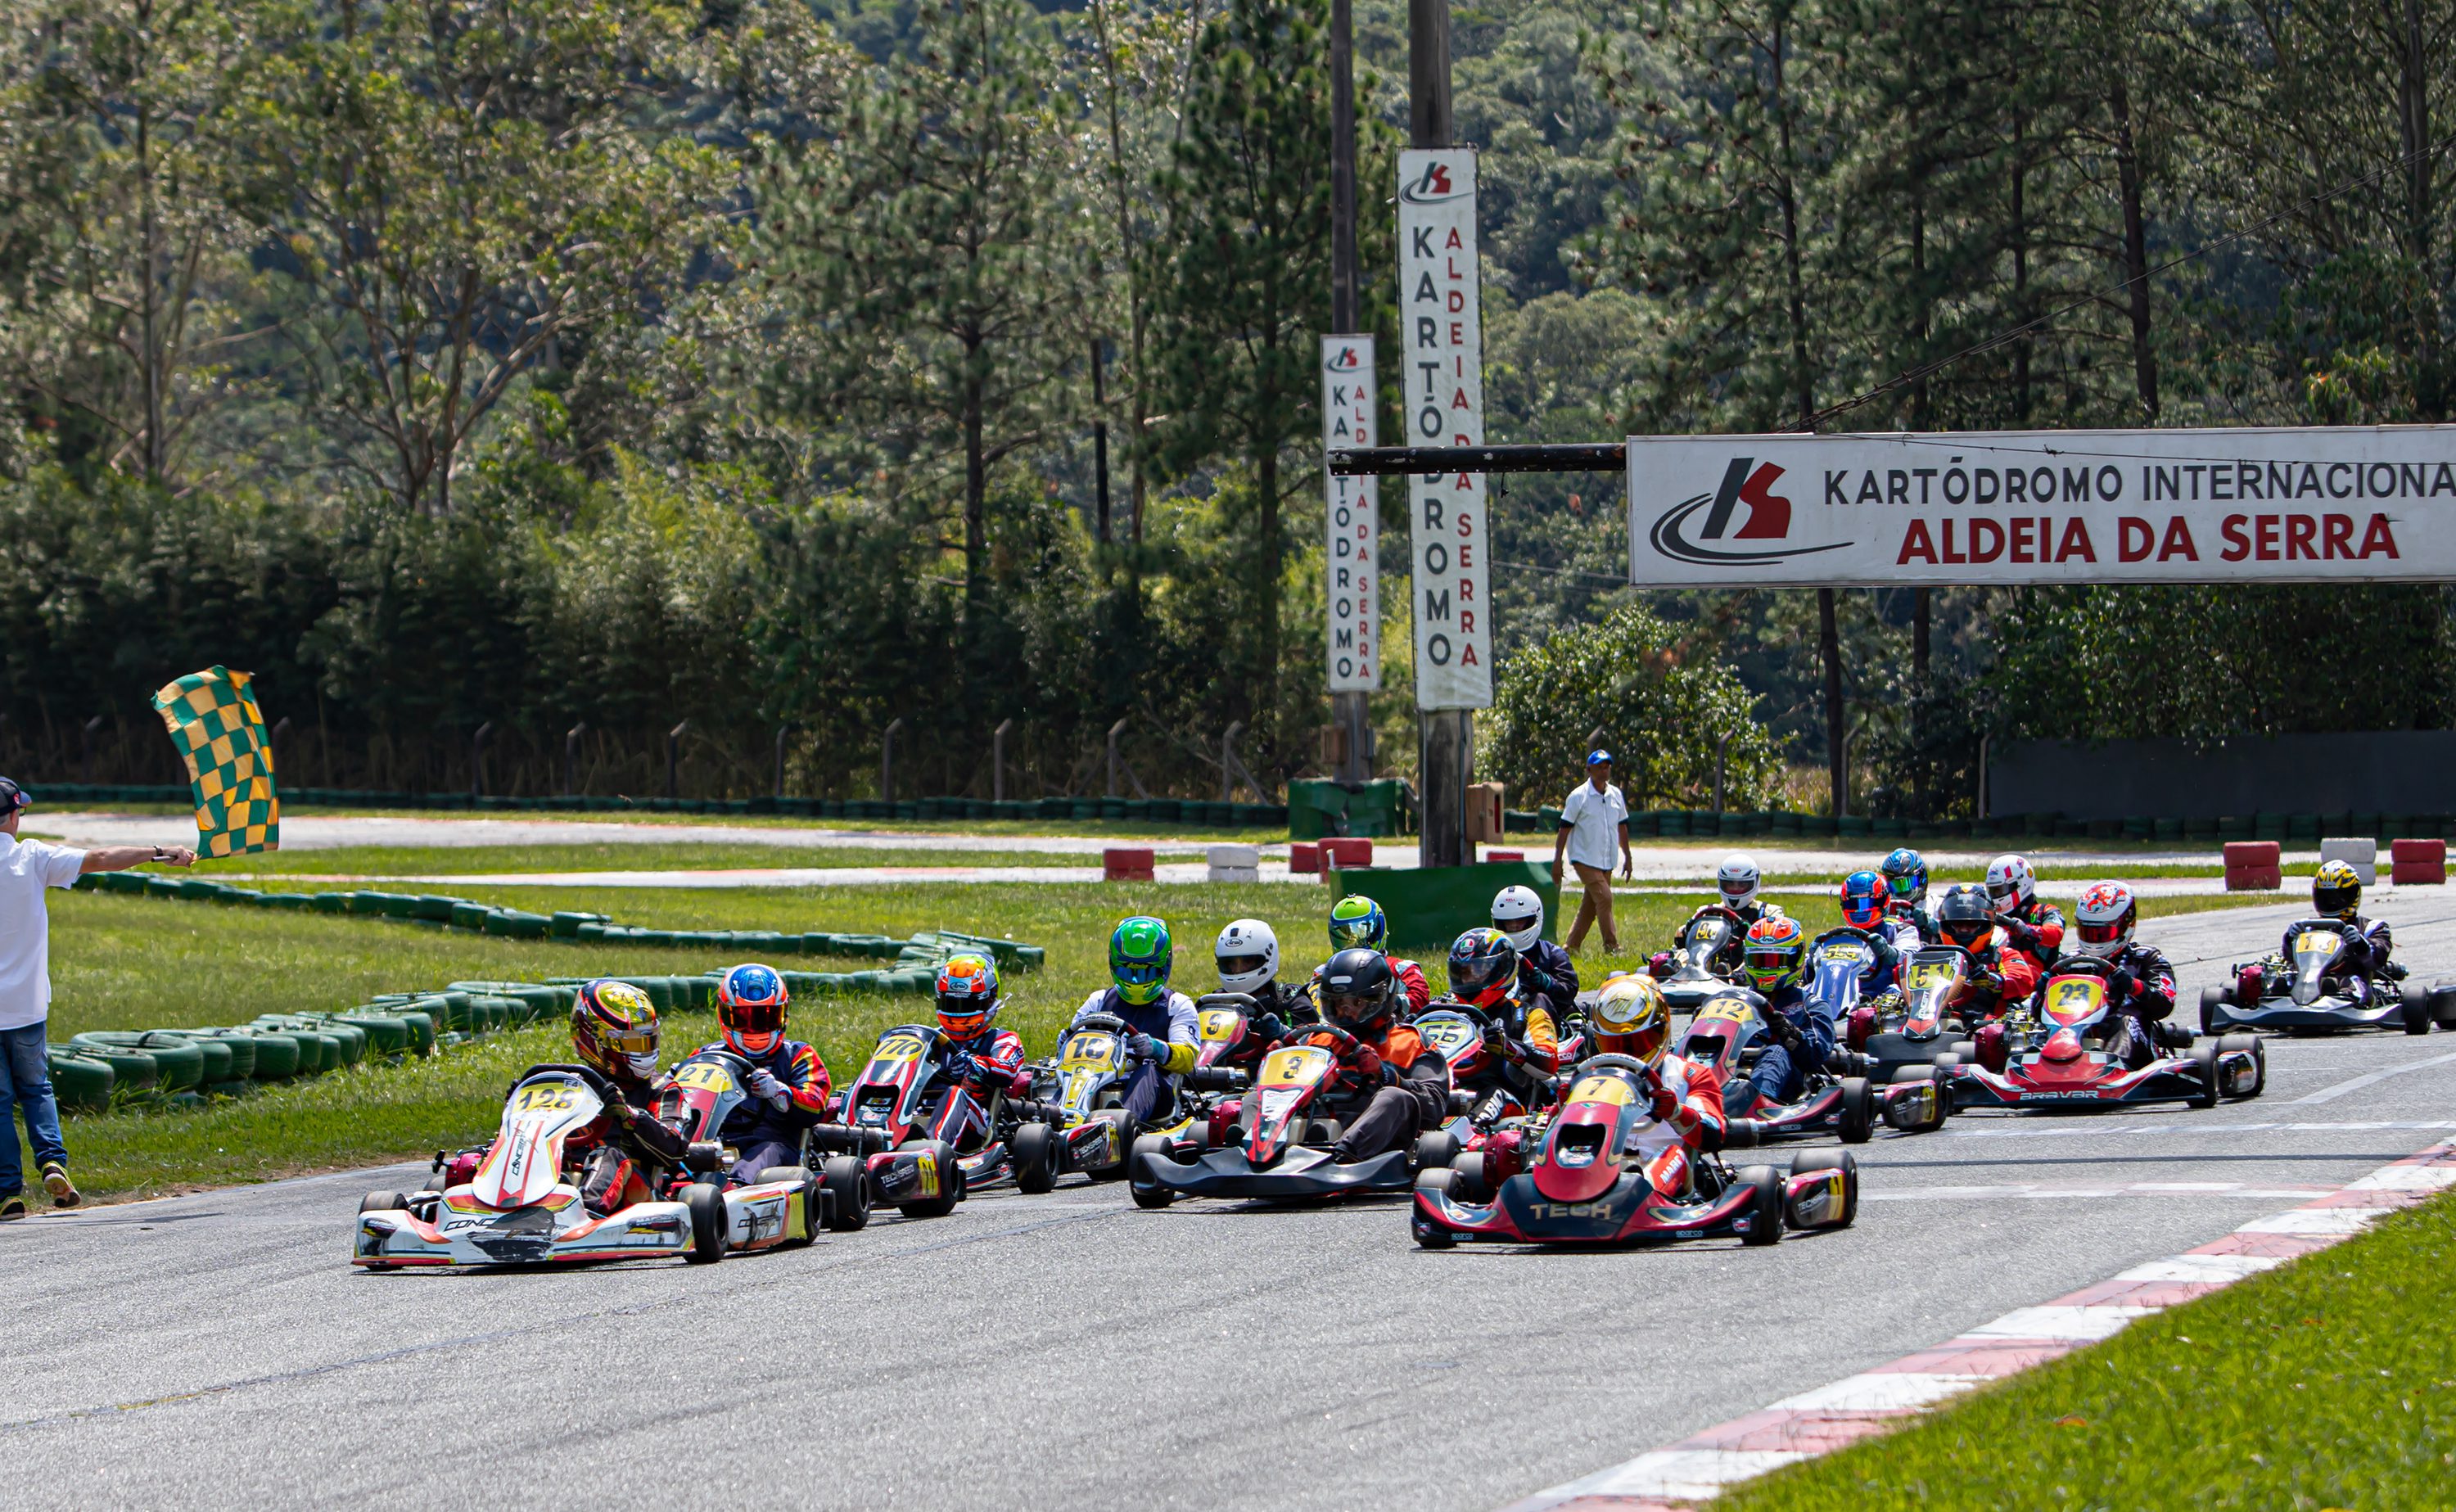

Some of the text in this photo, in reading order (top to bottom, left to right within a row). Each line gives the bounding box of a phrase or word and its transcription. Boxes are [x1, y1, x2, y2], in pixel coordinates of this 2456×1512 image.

[1445, 226, 1470, 409] ALDEIA
[1825, 457, 2122, 505] KARTÓDROMO
[1334, 386, 1352, 678] KATÓDROMO
[1354, 386, 1370, 678] ALDIA DA SERRA
[1896, 512, 2400, 565] ALDEIA DA SERRA
[1457, 513, 1478, 666] SERRA
[2057, 983, 2090, 1007] 23
[678, 1066, 716, 1084] 21
[1283, 1056, 1302, 1079] 3
[1588, 1079, 1607, 1095] 7
[1529, 1203, 1612, 1221] TECH
